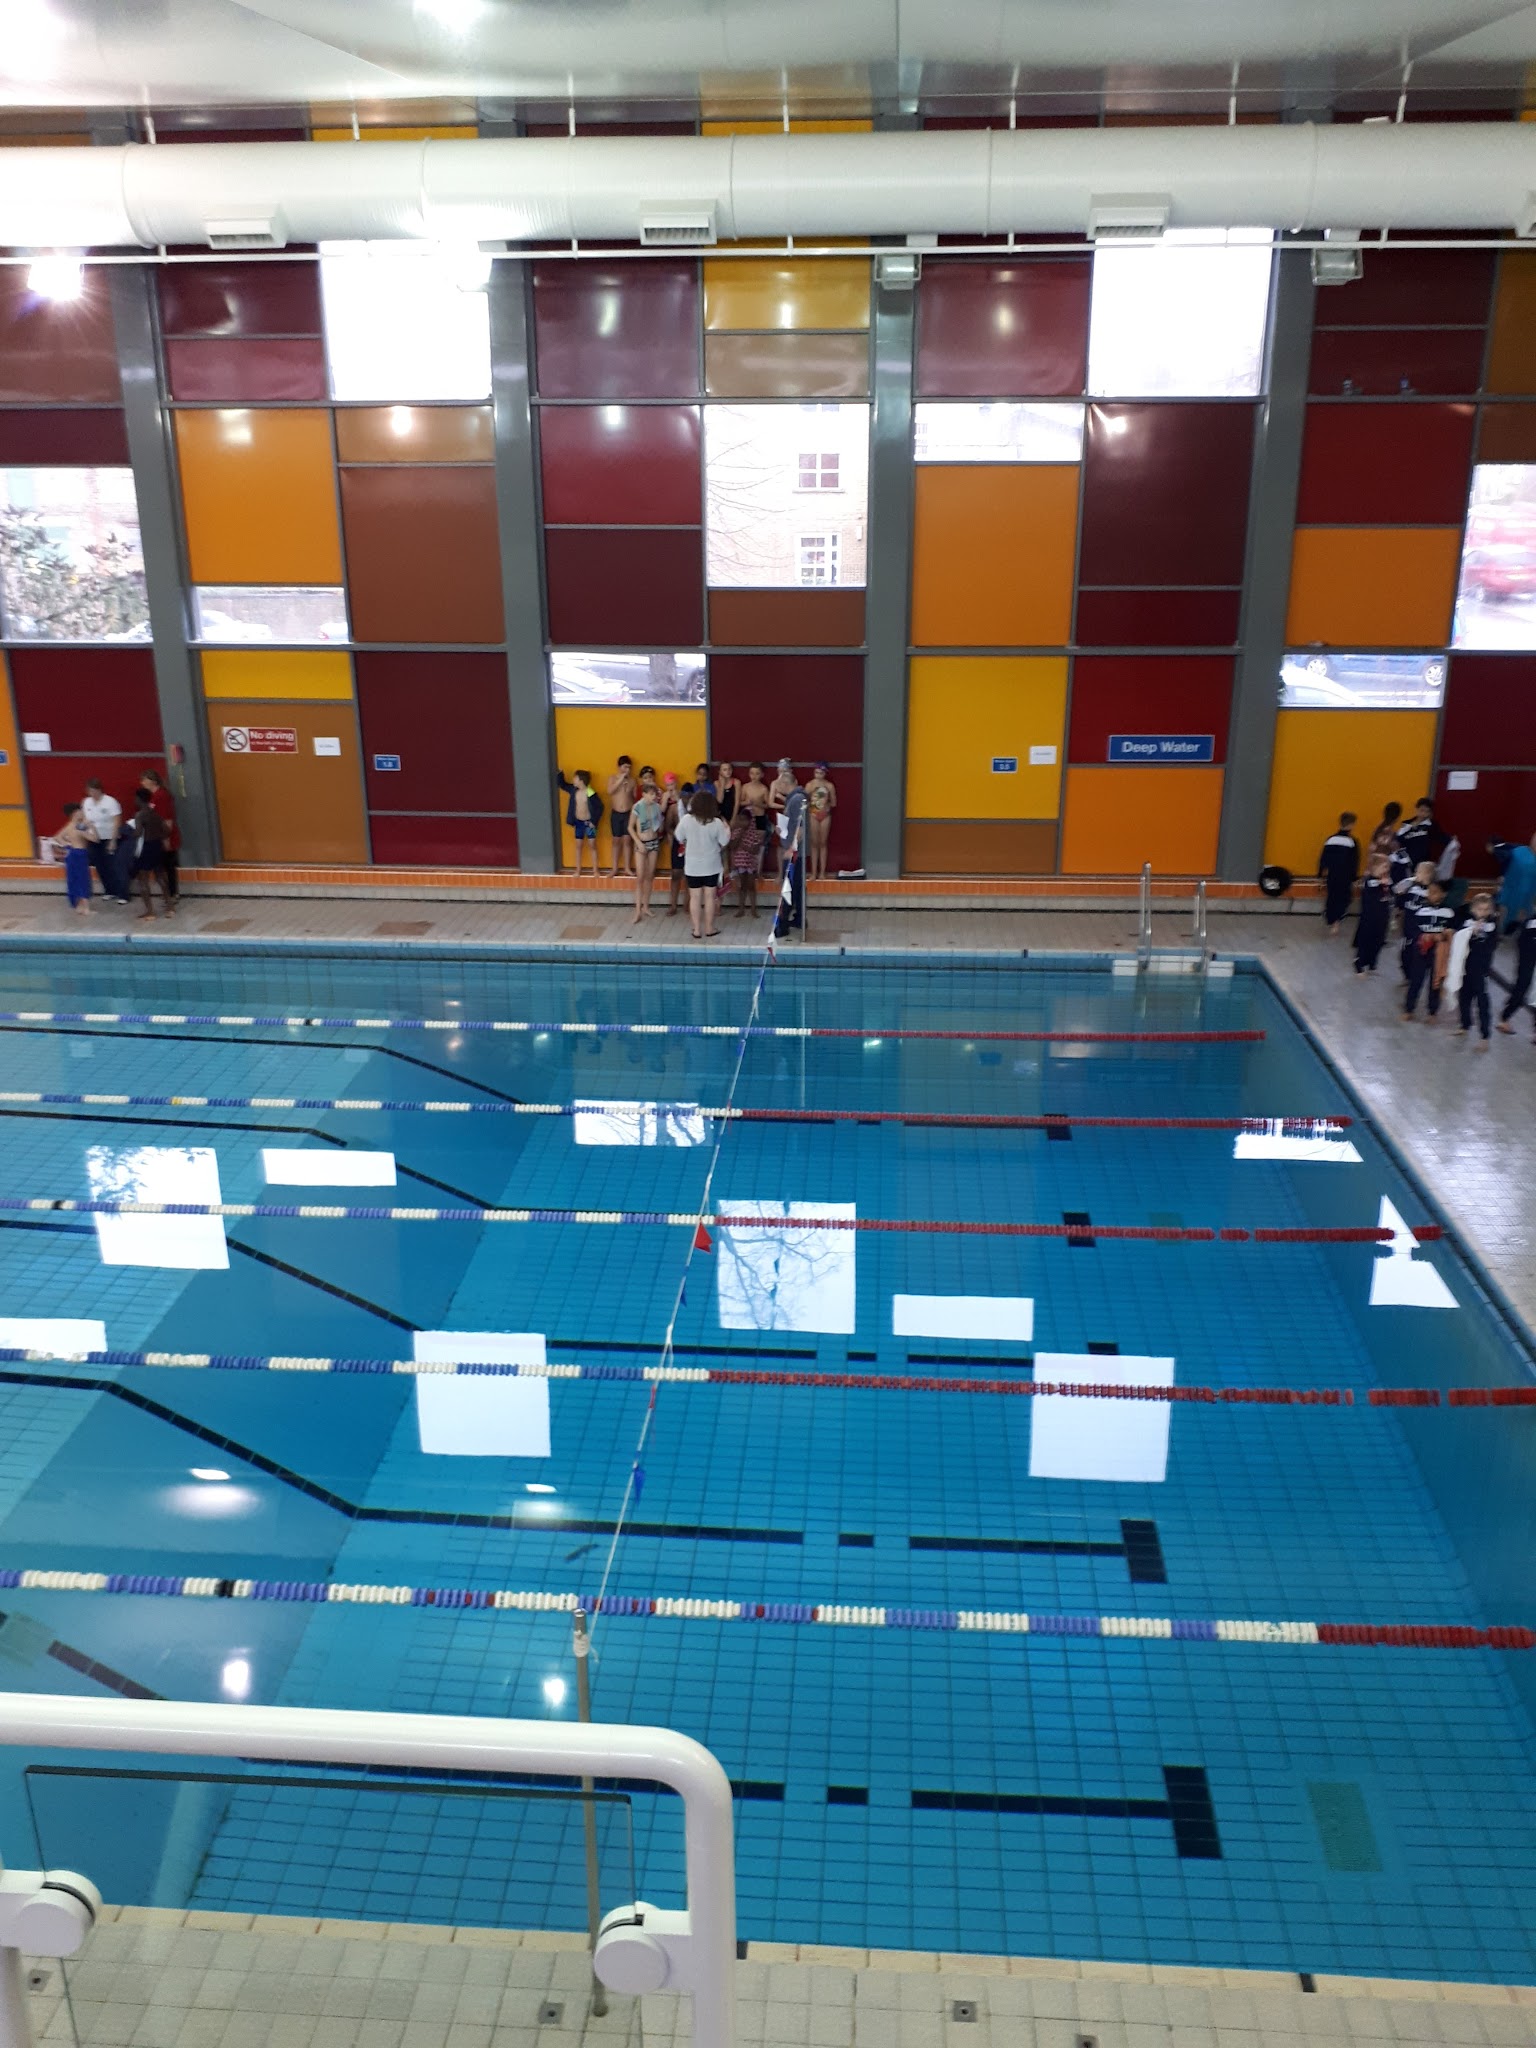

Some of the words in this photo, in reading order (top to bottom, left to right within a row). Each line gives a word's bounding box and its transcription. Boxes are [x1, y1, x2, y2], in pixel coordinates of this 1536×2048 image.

[250, 731, 264, 739] No
[265, 731, 294, 741] diving
[1122, 742, 1158, 755] Deep
[1160, 741, 1200, 753] Water
